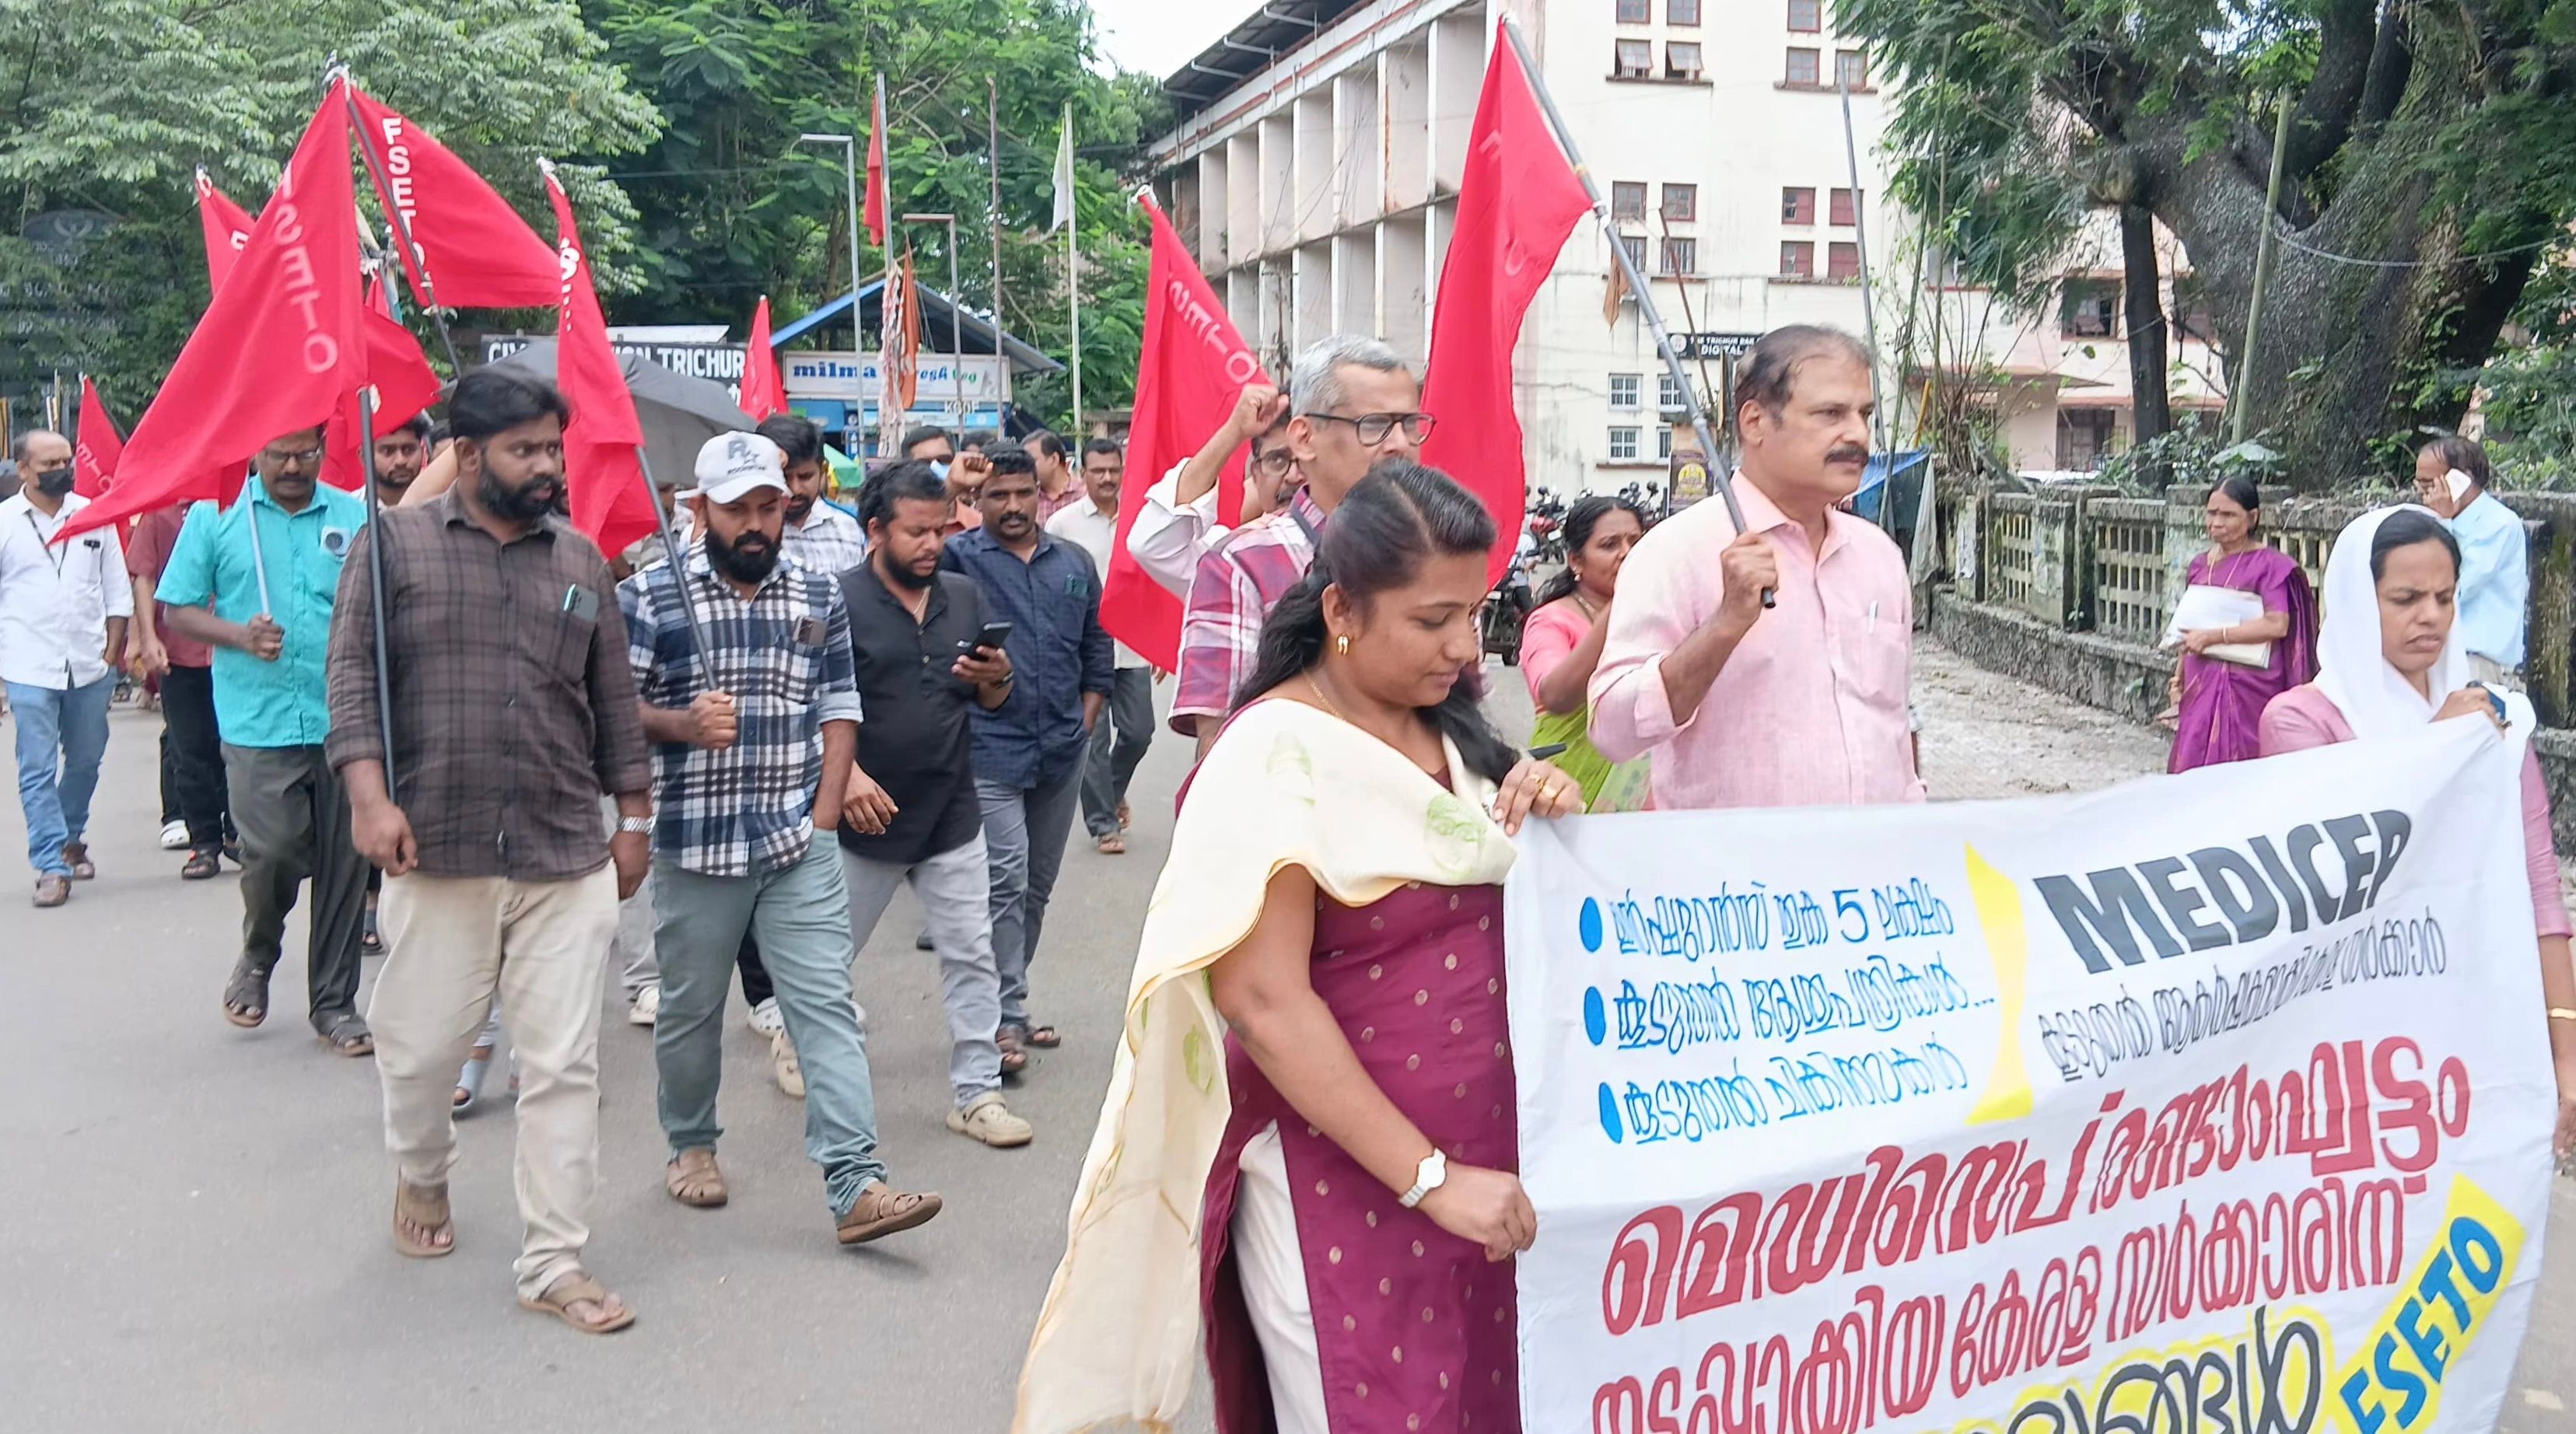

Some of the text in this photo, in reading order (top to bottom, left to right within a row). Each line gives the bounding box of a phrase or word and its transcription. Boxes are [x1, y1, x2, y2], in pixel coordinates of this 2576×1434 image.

[660, 349, 746, 379] TRICHUR
[793, 362, 877, 379] milma
[1701, 345, 1744, 355] DIGTAL
[1832, 889, 1868, 943] 5
[1871, 877, 1955, 940] ലക്ഷം
[2033, 809, 2412, 974] MEDICEP
[1950, 1245, 2101, 1399] കേരള
[2105, 1173, 2427, 1342] സർക്കാരിന്
[2340, 1216, 2503, 1434] FSETO
